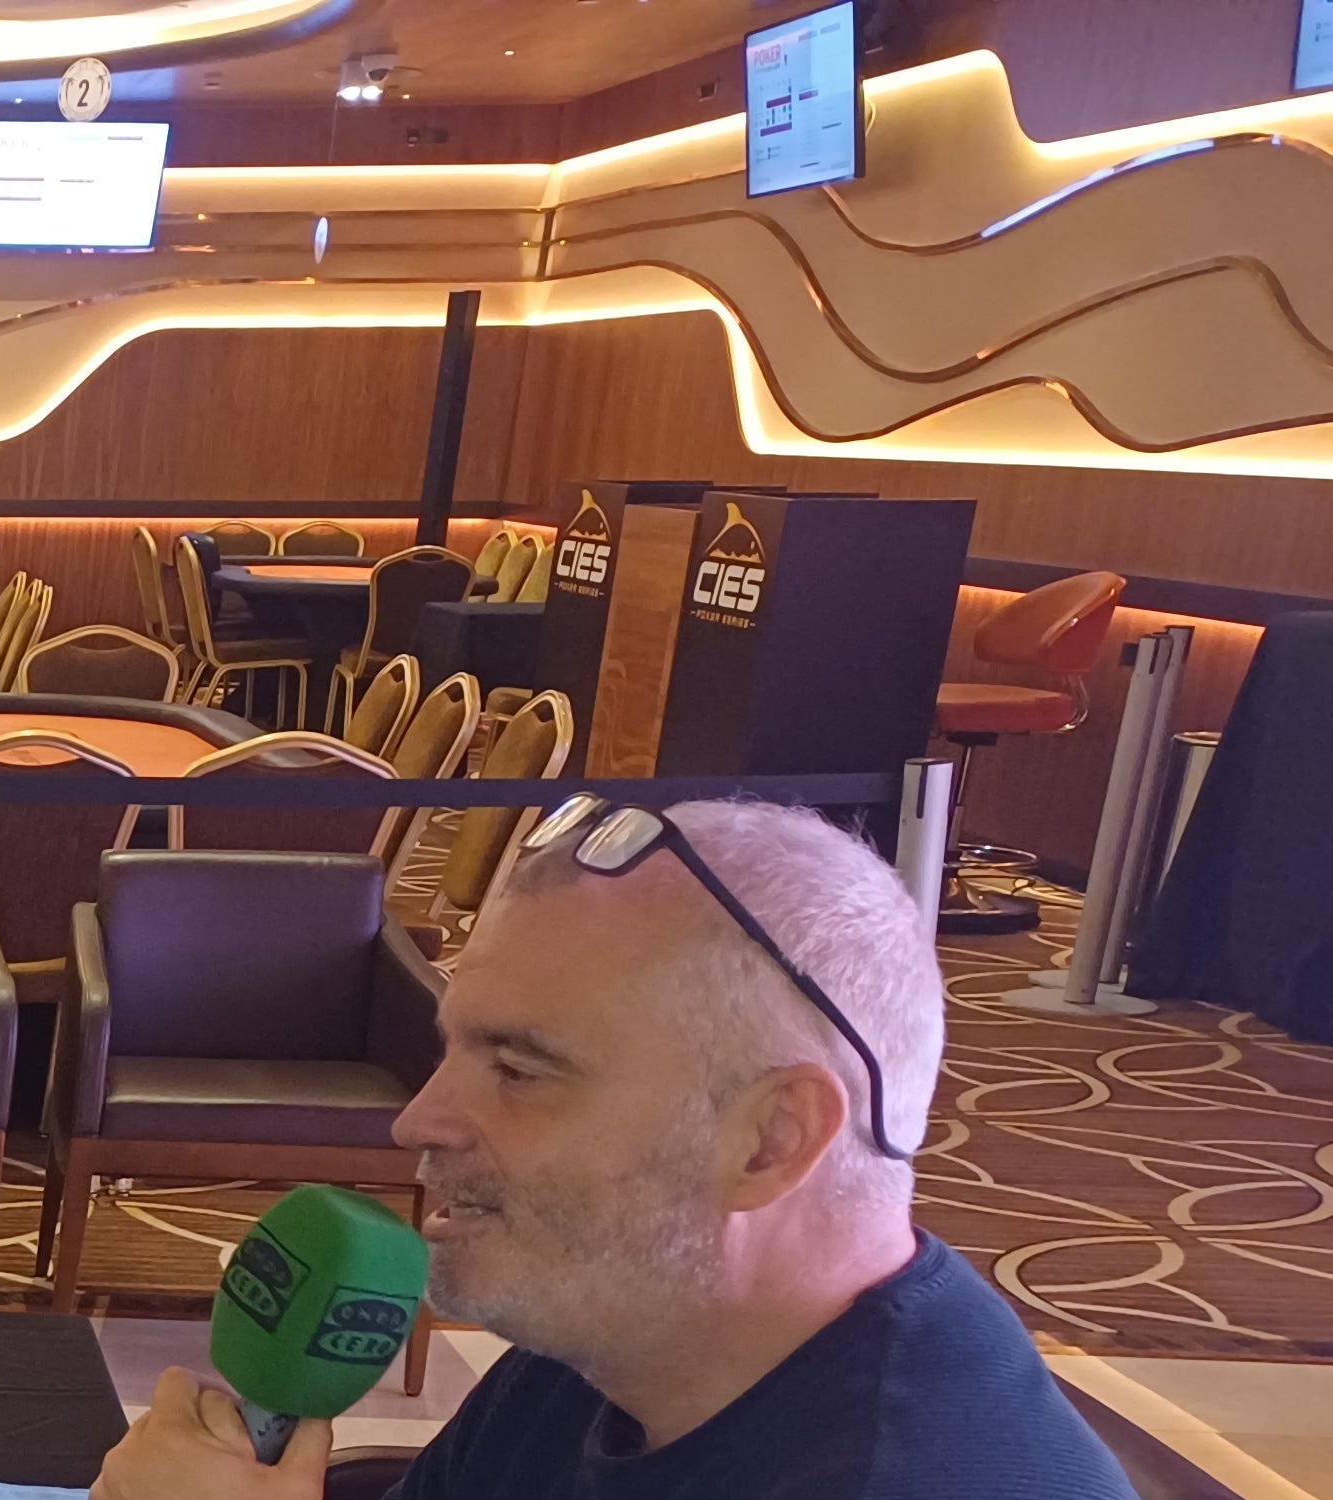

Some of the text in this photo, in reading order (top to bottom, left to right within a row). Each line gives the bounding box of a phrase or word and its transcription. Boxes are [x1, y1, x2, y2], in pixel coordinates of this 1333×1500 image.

[753, 44, 782, 67] POKER
[76, 78, 91, 108] 2
[556, 538, 612, 584] CIES
[693, 560, 766, 613] CIES
[329, 1333, 392, 1356] CERO
